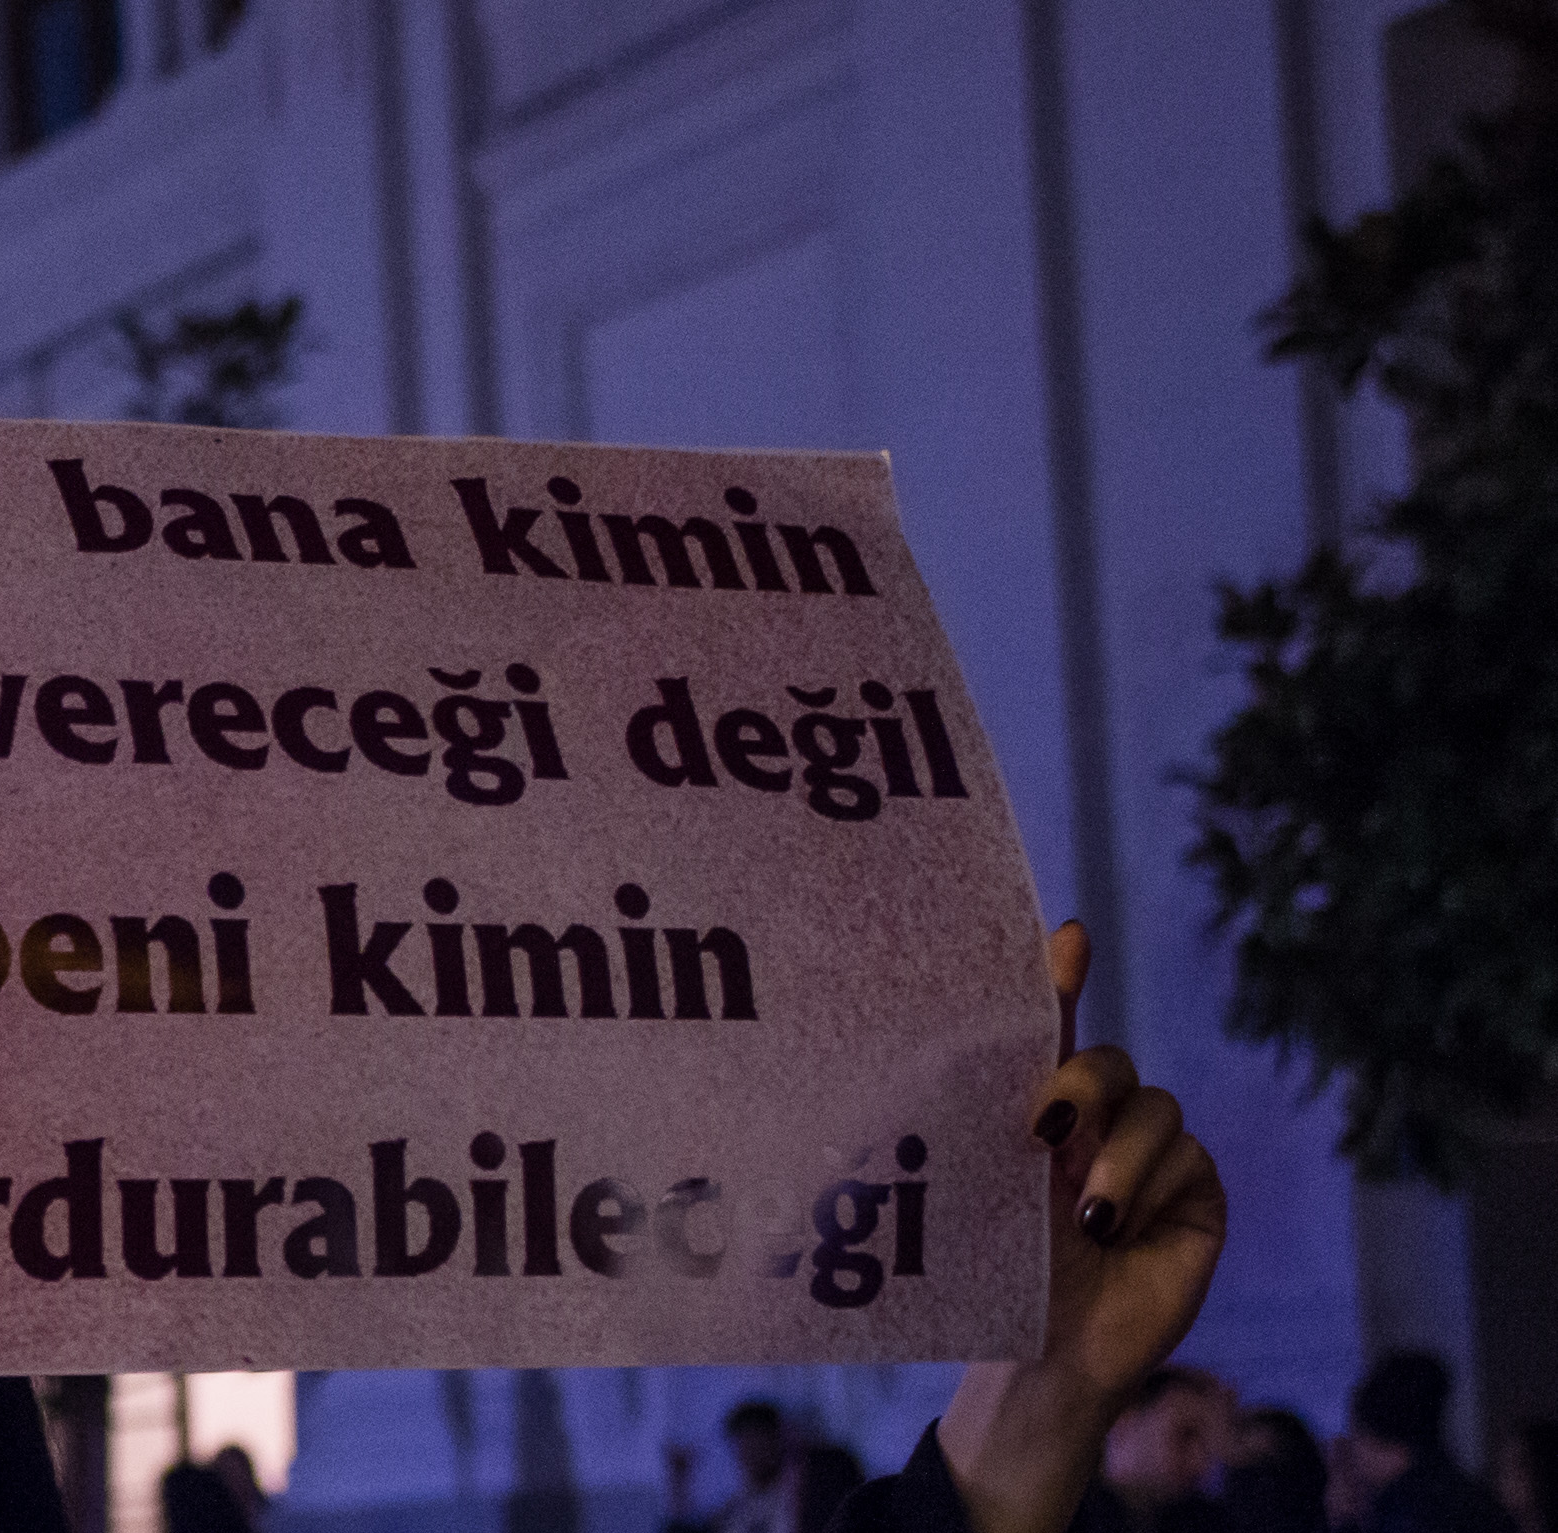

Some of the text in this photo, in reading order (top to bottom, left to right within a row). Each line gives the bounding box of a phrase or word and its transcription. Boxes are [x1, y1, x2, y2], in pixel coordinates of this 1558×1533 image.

[49, 459, 416, 567] bana
[453, 475, 878, 597] kimin
[627, 677, 967, 822] değil
[319, 878, 758, 1020] kimin
